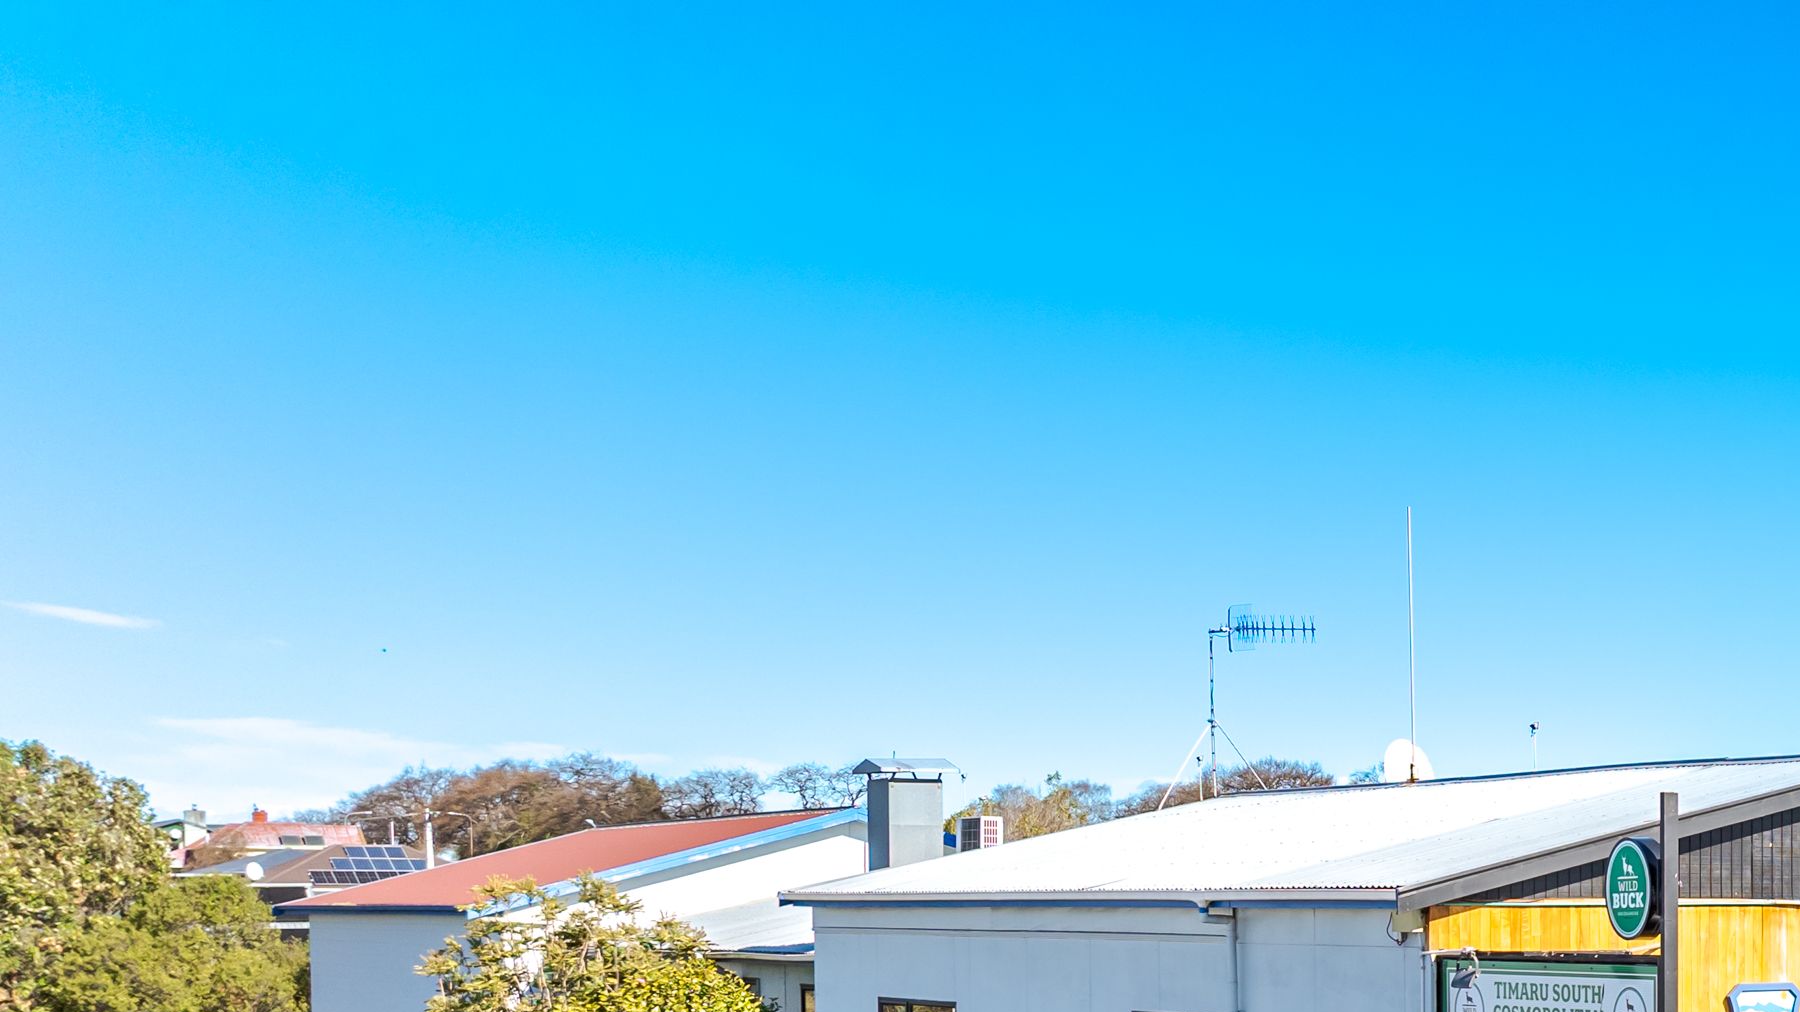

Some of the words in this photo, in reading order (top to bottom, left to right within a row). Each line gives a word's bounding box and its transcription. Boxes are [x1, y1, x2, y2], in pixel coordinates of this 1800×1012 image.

[1617, 880, 1638, 892] WILD
[1612, 892, 1644, 909] BUCK
[1494, 981, 1549, 1001] TIMARU
[1552, 983, 1602, 1004] SOUTH
